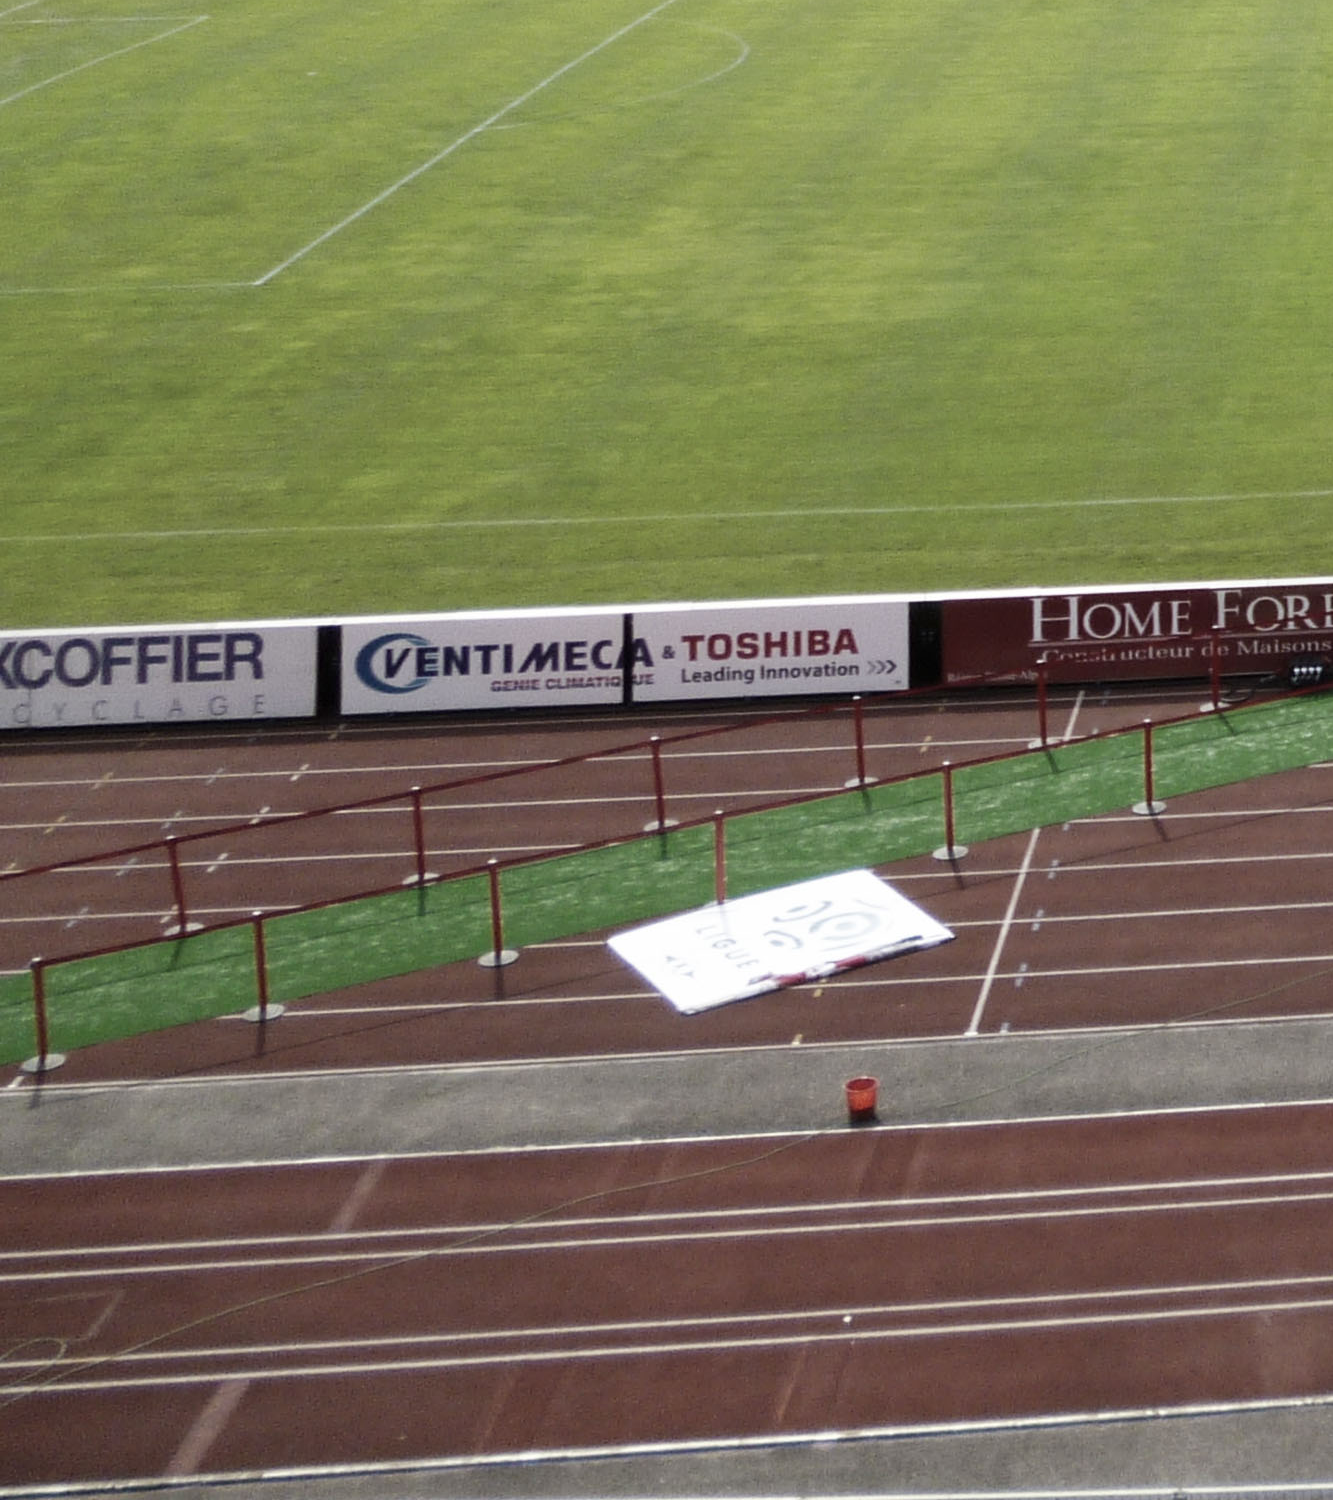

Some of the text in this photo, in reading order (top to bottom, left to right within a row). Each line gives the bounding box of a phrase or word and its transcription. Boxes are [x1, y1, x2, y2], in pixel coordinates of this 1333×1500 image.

[1029, 596, 1193, 642] HOME
[384, 637, 676, 680] VENTIMECA &
[681, 628, 860, 662] TOSHIBA
[1201, 639, 1231, 657] de
[1236, 636, 1333, 656] Maisons
[490, 674, 655, 692] GENIE CLIMATIQUE
[681, 661, 860, 685] Leading Innovation
